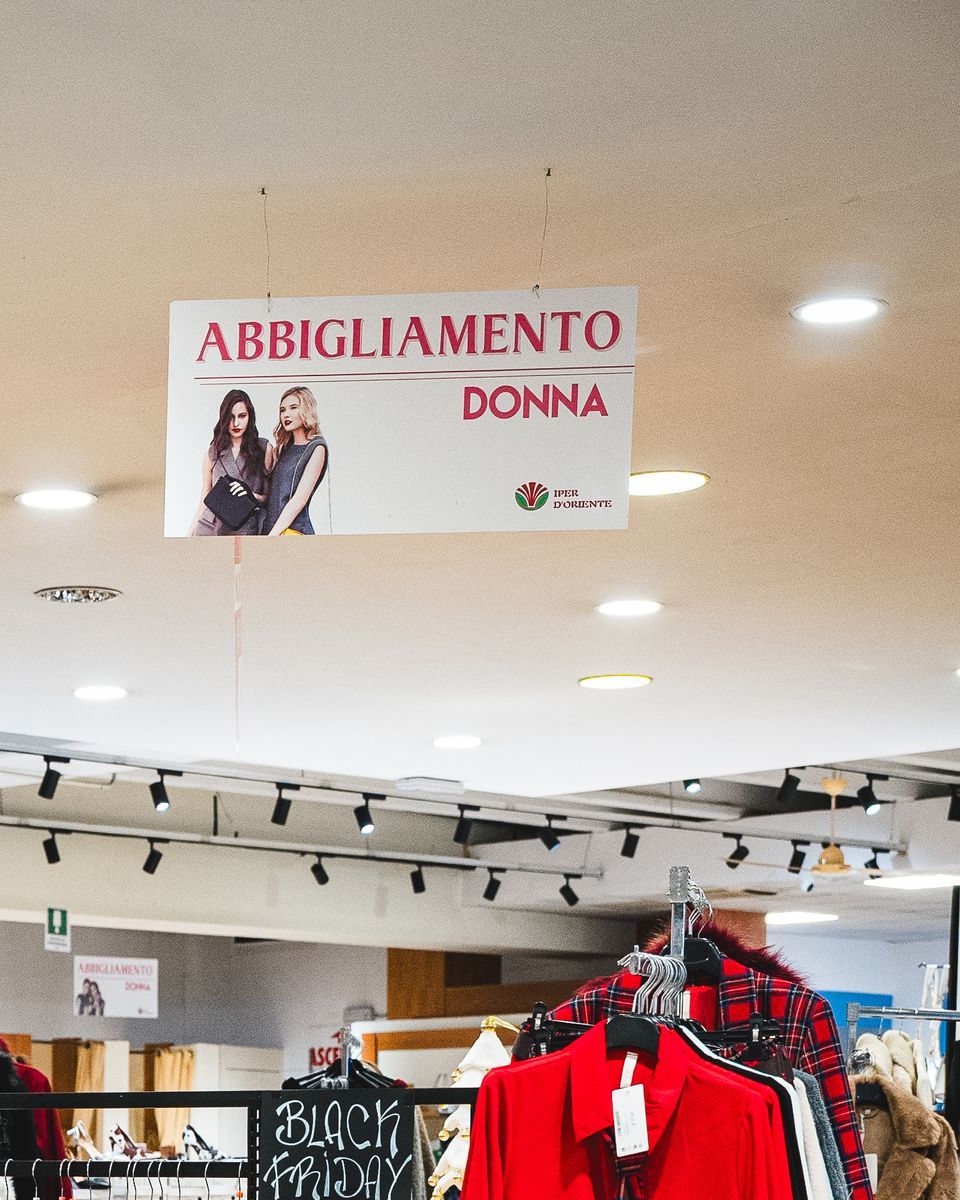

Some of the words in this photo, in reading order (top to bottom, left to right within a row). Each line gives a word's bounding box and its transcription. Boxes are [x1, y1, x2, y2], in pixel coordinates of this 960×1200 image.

[196, 310, 623, 362] ABBIGLIAMENTO
[463, 383, 609, 420] DONNA
[553, 489, 579, 498] IPER
[553, 500, 612, 509] D'ORIENTE
[79, 962, 153, 976] ABBIGLIAMENTO
[275, 1099, 401, 1159] BLACK
